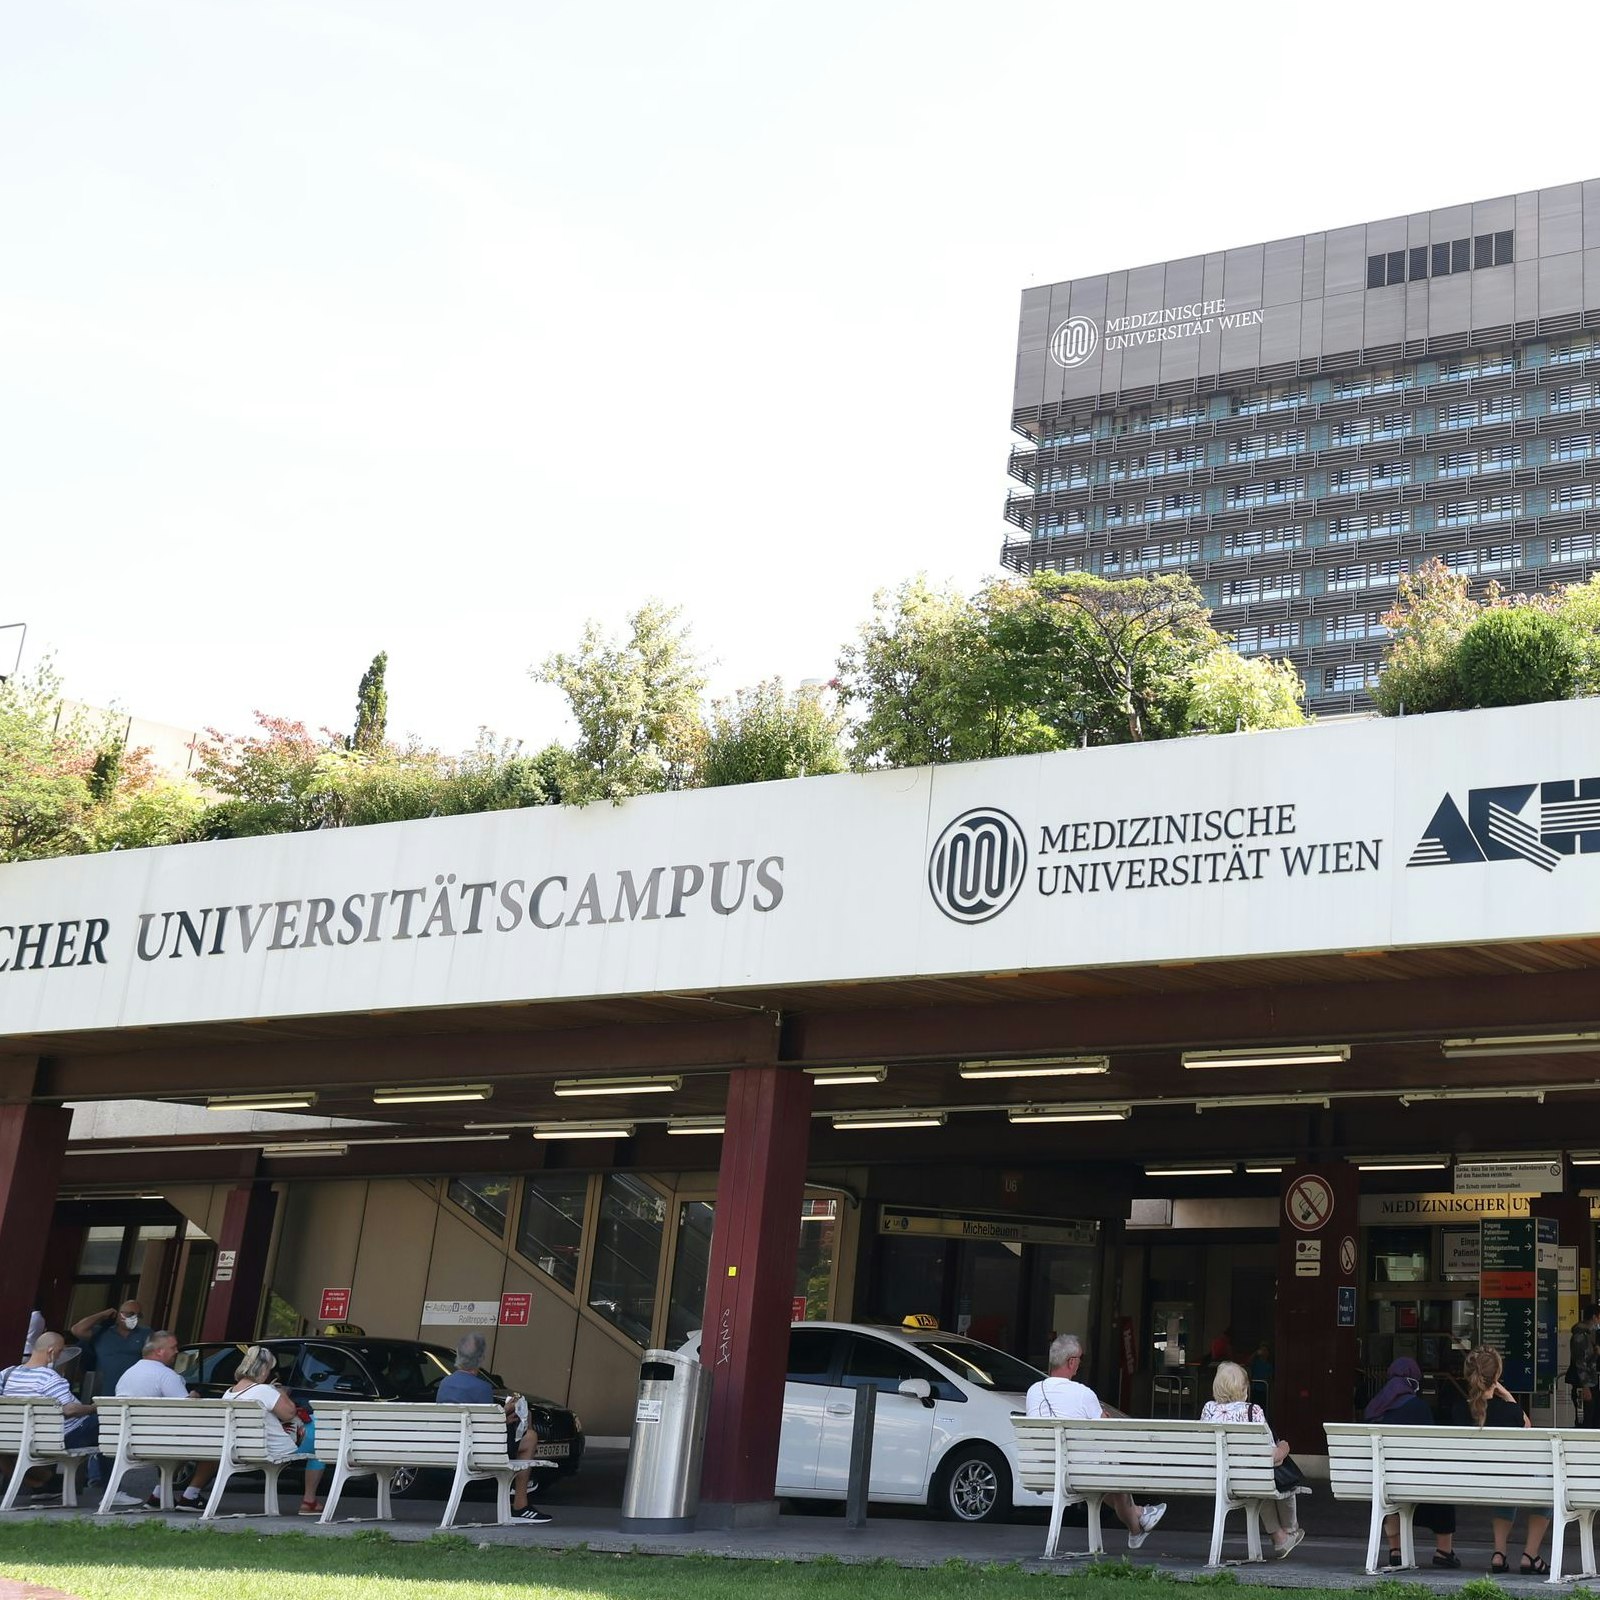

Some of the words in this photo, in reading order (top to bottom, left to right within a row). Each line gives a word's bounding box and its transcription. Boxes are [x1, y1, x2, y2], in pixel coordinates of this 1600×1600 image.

[1104, 298, 1226, 334] MEDIZINISCHE
[1104, 317, 1214, 351] UNIVERSITÄT
[1219, 309, 1265, 331] WIEN
[1038, 803, 1297, 856] MEDIZINISCHE
[1036, 841, 1265, 897] UNIVERSITÄT
[1264, 838, 1383, 877] WIEN
[0, 916, 109, 973] HER
[136, 854, 785, 962] UNIVERSITÄTSCAMPUS
[1005, 1179, 1017, 1192] U6
[1382, 1197, 1506, 1214] MEDIZINISCHER
[962, 1221, 1019, 1238] Michelbeuern
[458, 1315, 488, 1325] Rolltreppe
